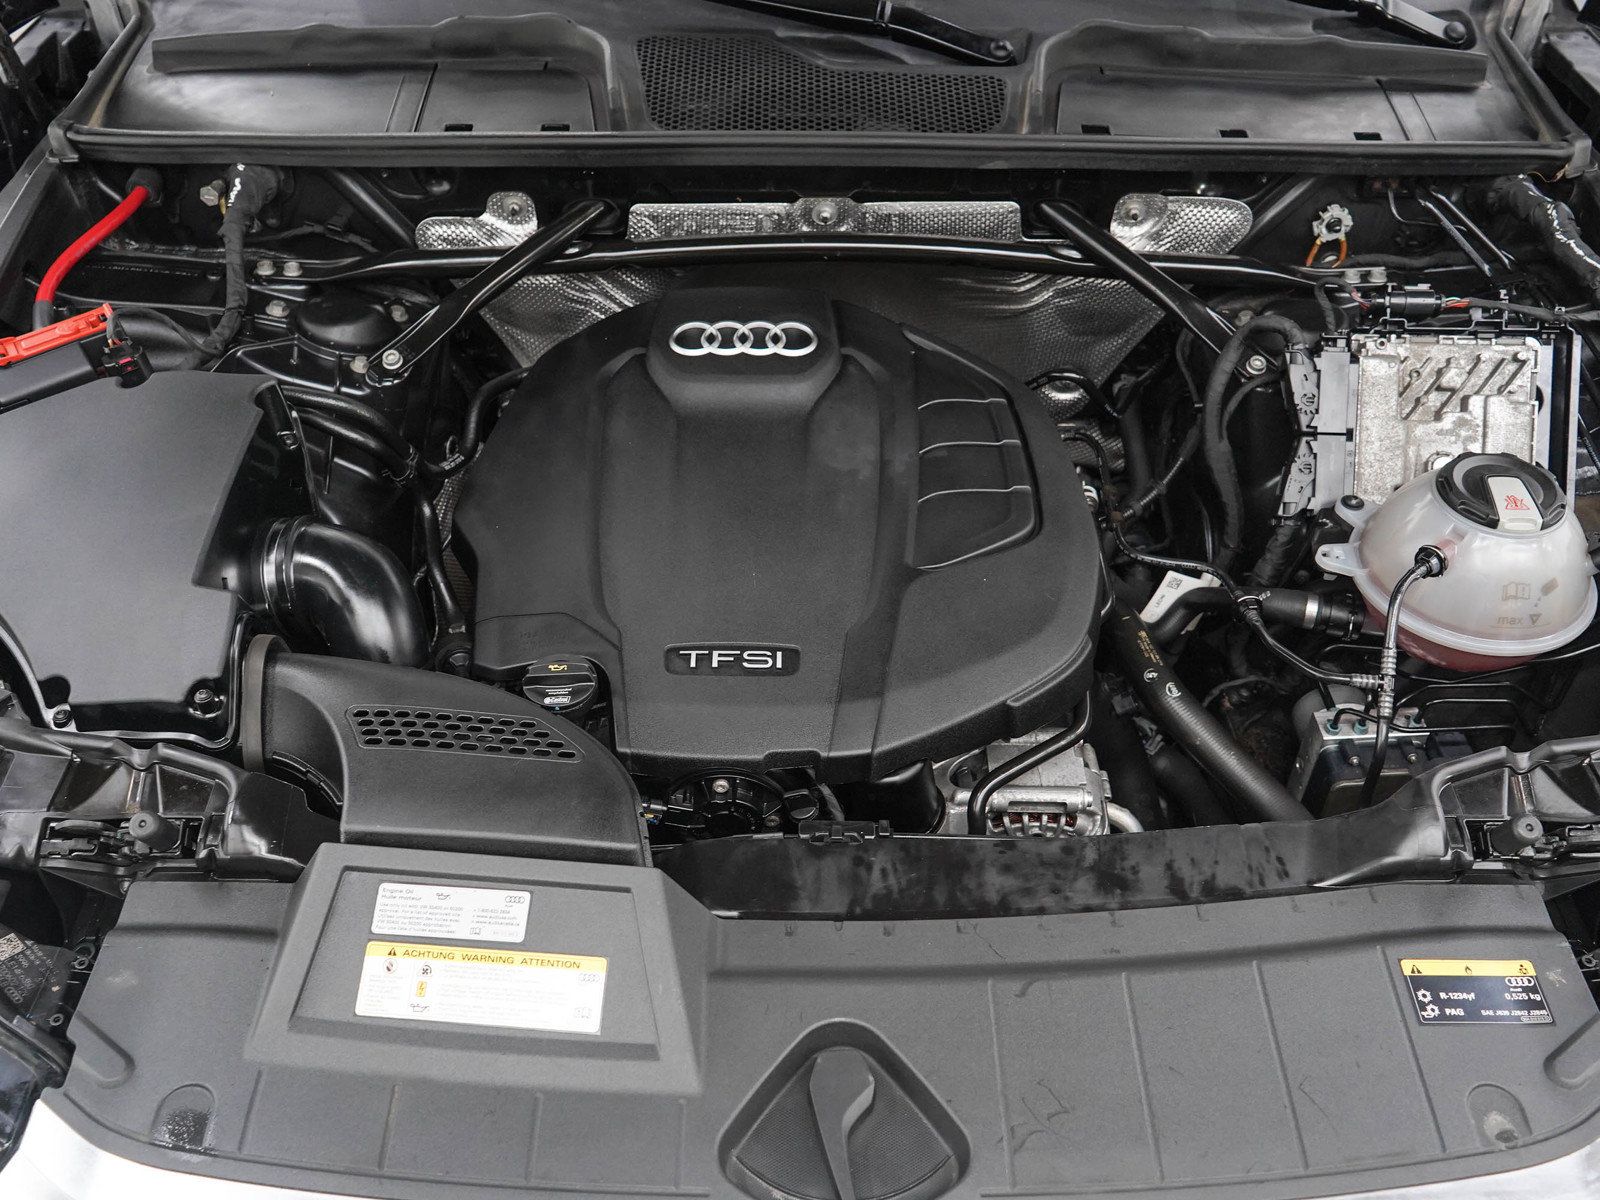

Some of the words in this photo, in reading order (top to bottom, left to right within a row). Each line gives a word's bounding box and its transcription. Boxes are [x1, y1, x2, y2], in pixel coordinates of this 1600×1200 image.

[1497, 616, 1523, 625] max
[679, 650, 783, 669] TFSI
[403, 950, 454, 960] ACHTUNG
[461, 953, 514, 964] WARNING
[520, 957, 581, 969] ATTENTION
[1439, 992, 1475, 1001] R-1234yf
[1504, 993, 1528, 1001] 0,525
[1529, 993, 1541, 1001] kg
[1445, 1008, 1465, 1016] PAG
